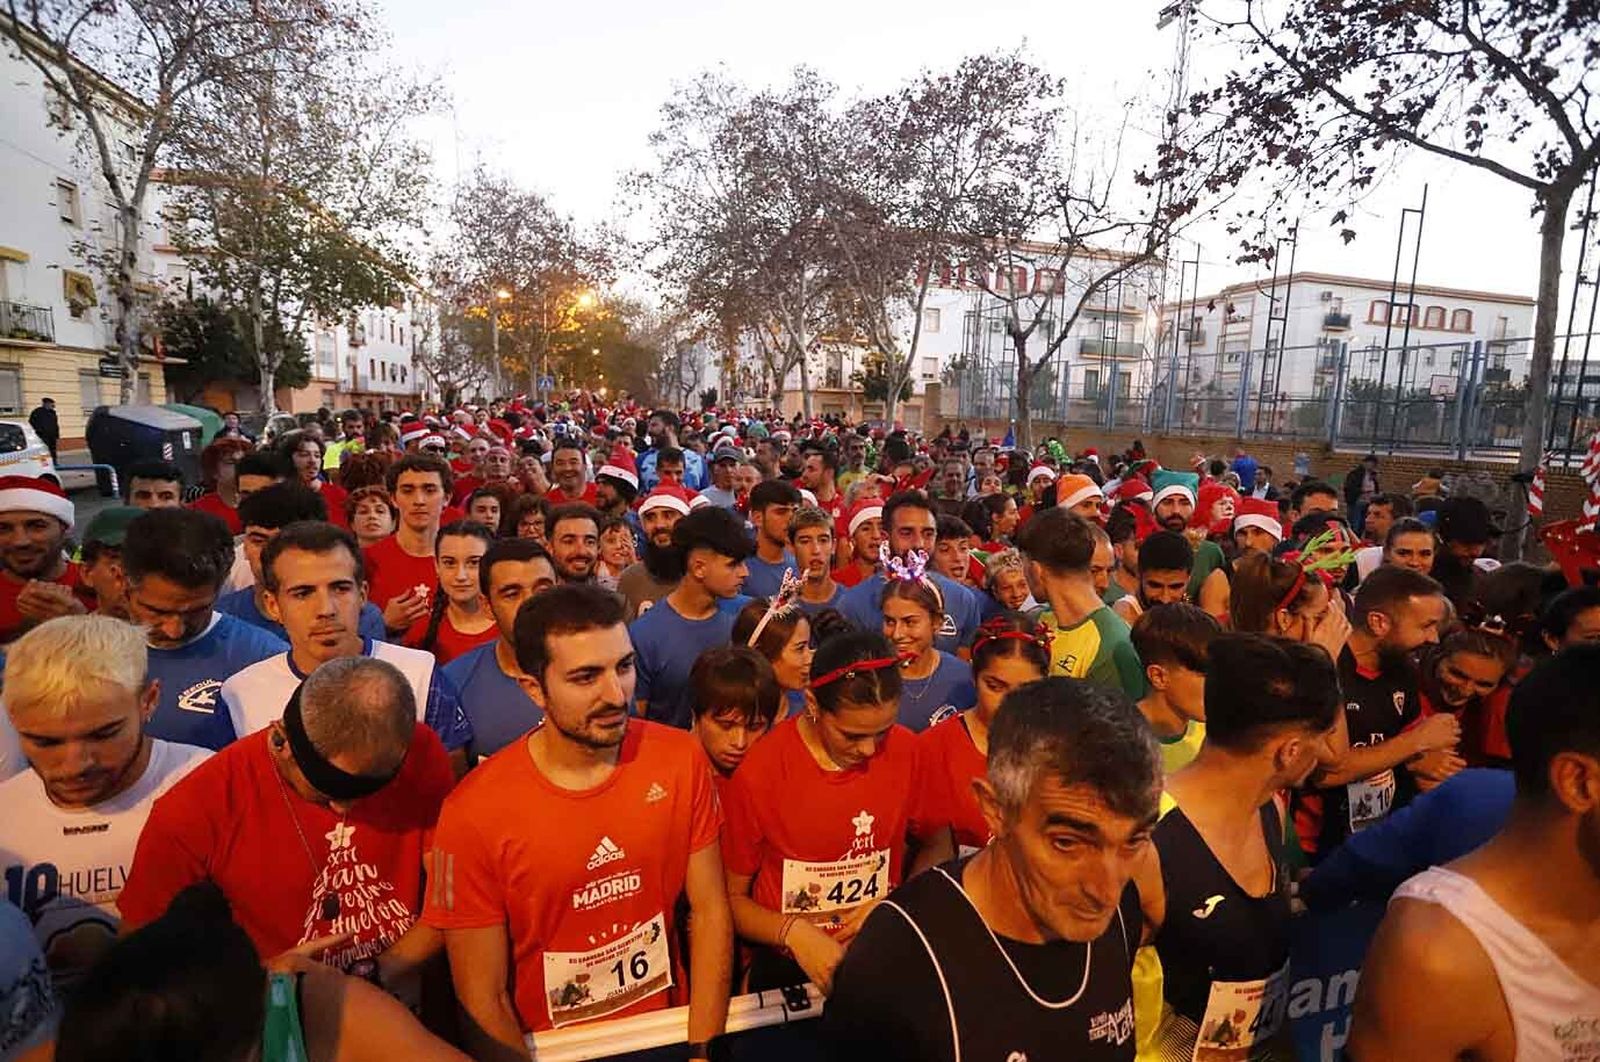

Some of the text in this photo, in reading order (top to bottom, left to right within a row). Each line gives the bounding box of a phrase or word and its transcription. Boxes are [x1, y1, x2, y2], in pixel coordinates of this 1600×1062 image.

[572, 874, 641, 909] MADRID
[826, 872, 879, 905] 424
[610, 950, 649, 987] 16
